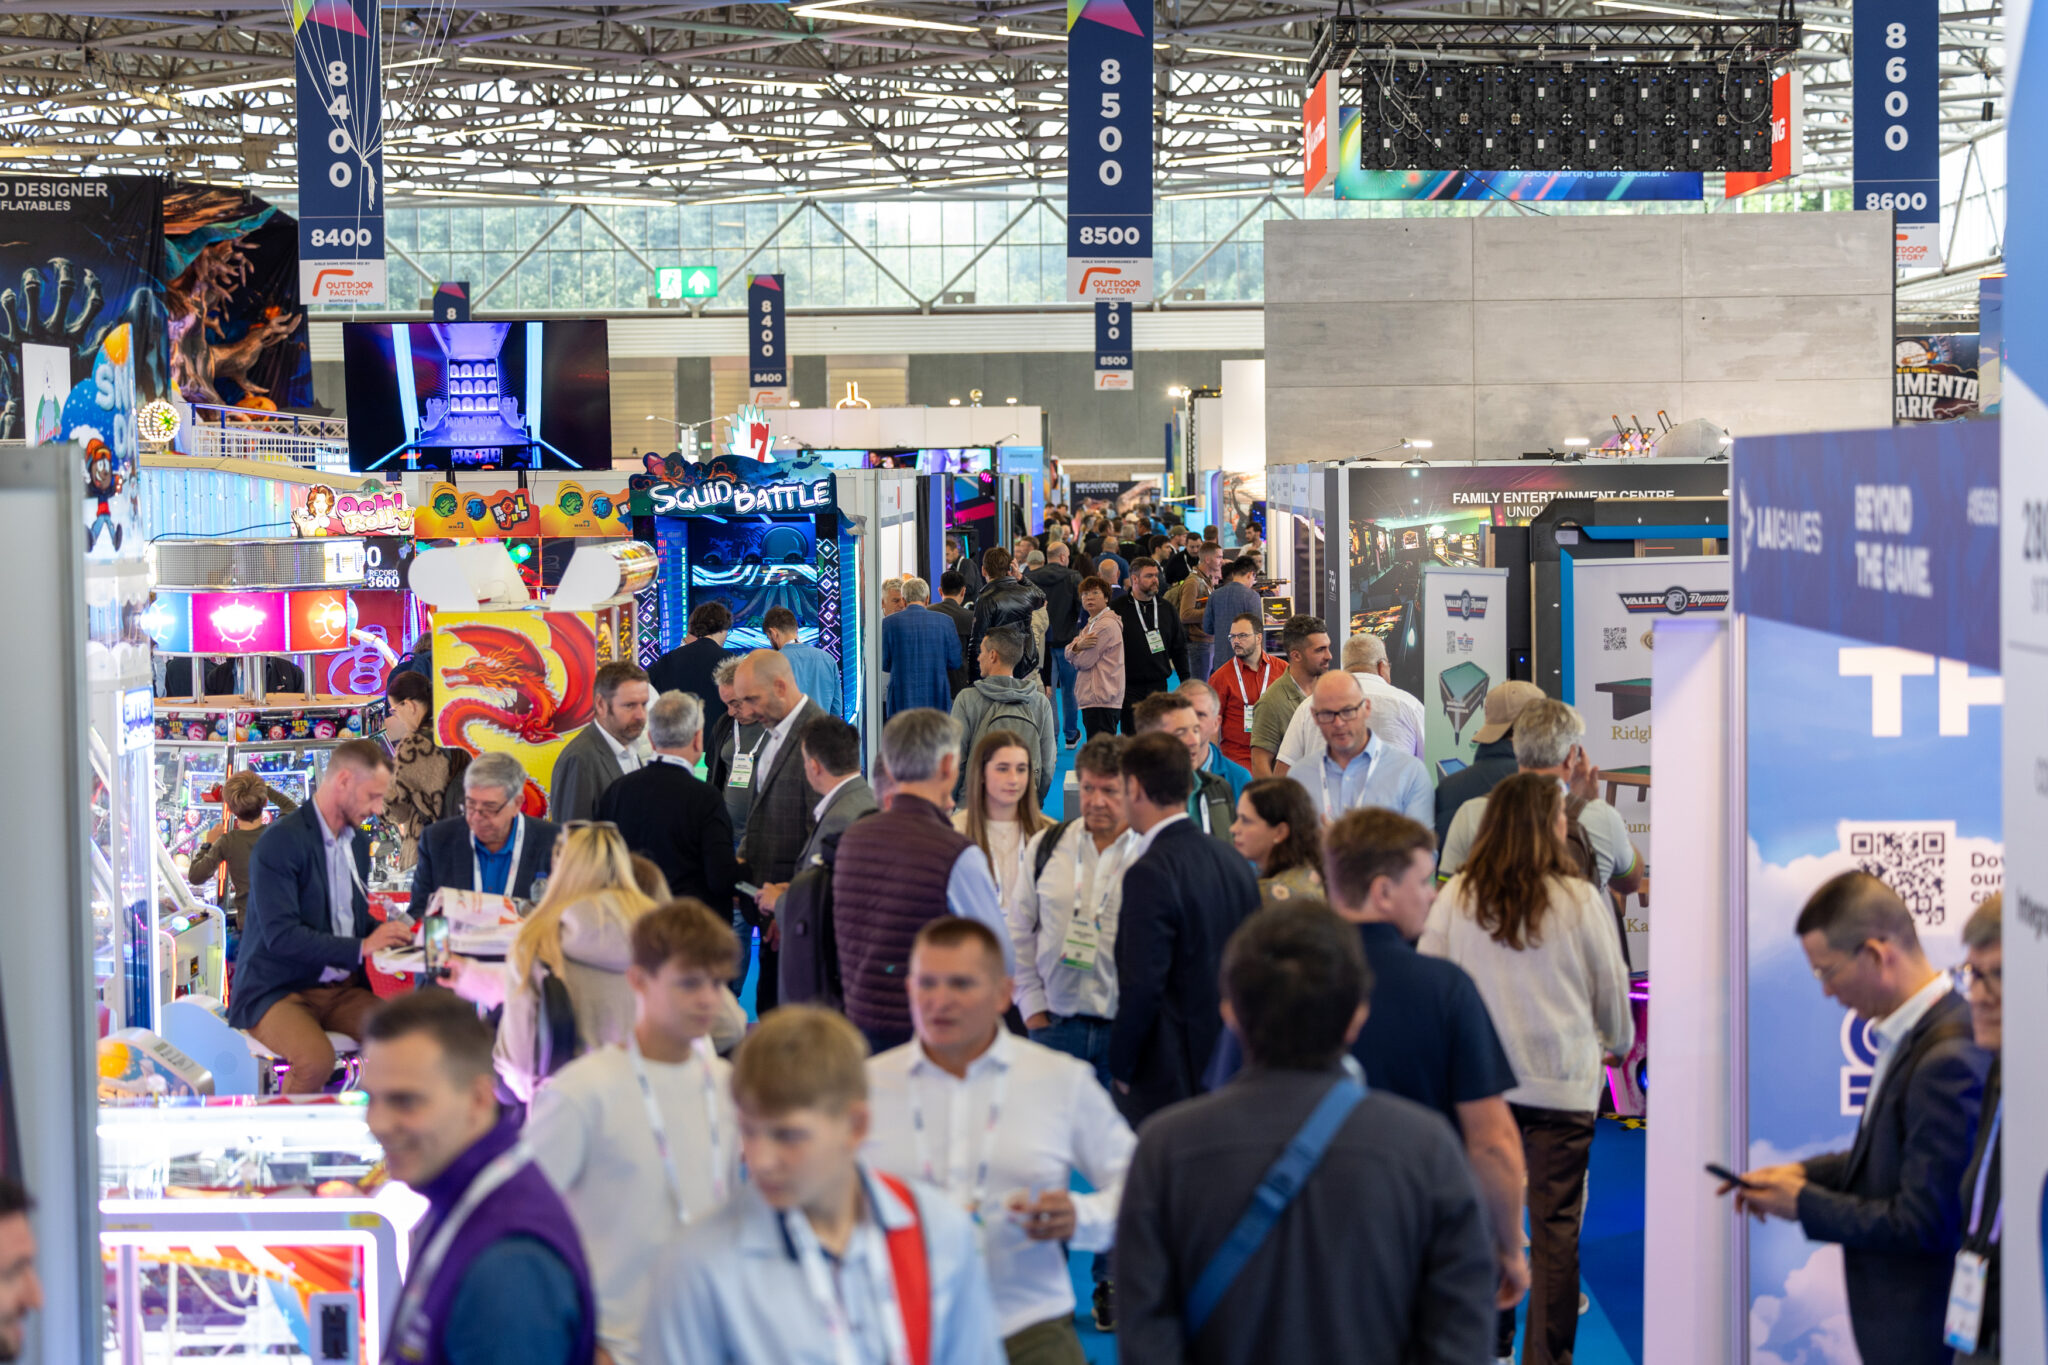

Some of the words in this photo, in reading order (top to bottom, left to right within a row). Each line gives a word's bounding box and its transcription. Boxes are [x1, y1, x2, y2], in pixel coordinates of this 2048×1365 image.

[1885, 22, 1909, 151] 8600
[327, 60, 353, 188] 8400
[1099, 58, 1123, 186] 8500
[15, 182, 108, 197] DESIGNER
[1, 200, 71, 212] FLATABLES
[1866, 192, 1927, 211] 8600
[311, 228, 372, 247] 8400
[1079, 226, 1140, 245] 8500
[326, 281, 373, 289] OUTDOOR
[1093, 279, 1141, 288] OUTDOOR
[1896, 396, 1937, 419] ARK
[649, 480, 733, 514] SQUID
[734, 480, 831, 514] BATTLE
[1453, 492, 1500, 504] FAMILY
[1504, 490, 1616, 504] ENTERTAINMENT
[1619, 490, 1675, 499] CENTRE
[1855, 484, 1913, 535] BEYOND
[369, 569, 399, 577] RECORD
[1856, 542, 1884, 590] THE
[368, 576, 400, 588] 3600
[1623, 596, 1666, 605] VALLEY
[1689, 592, 1728, 606] Dynamo
[1624, 818, 1651, 833] un
[1626, 917, 1648, 933] Ka
